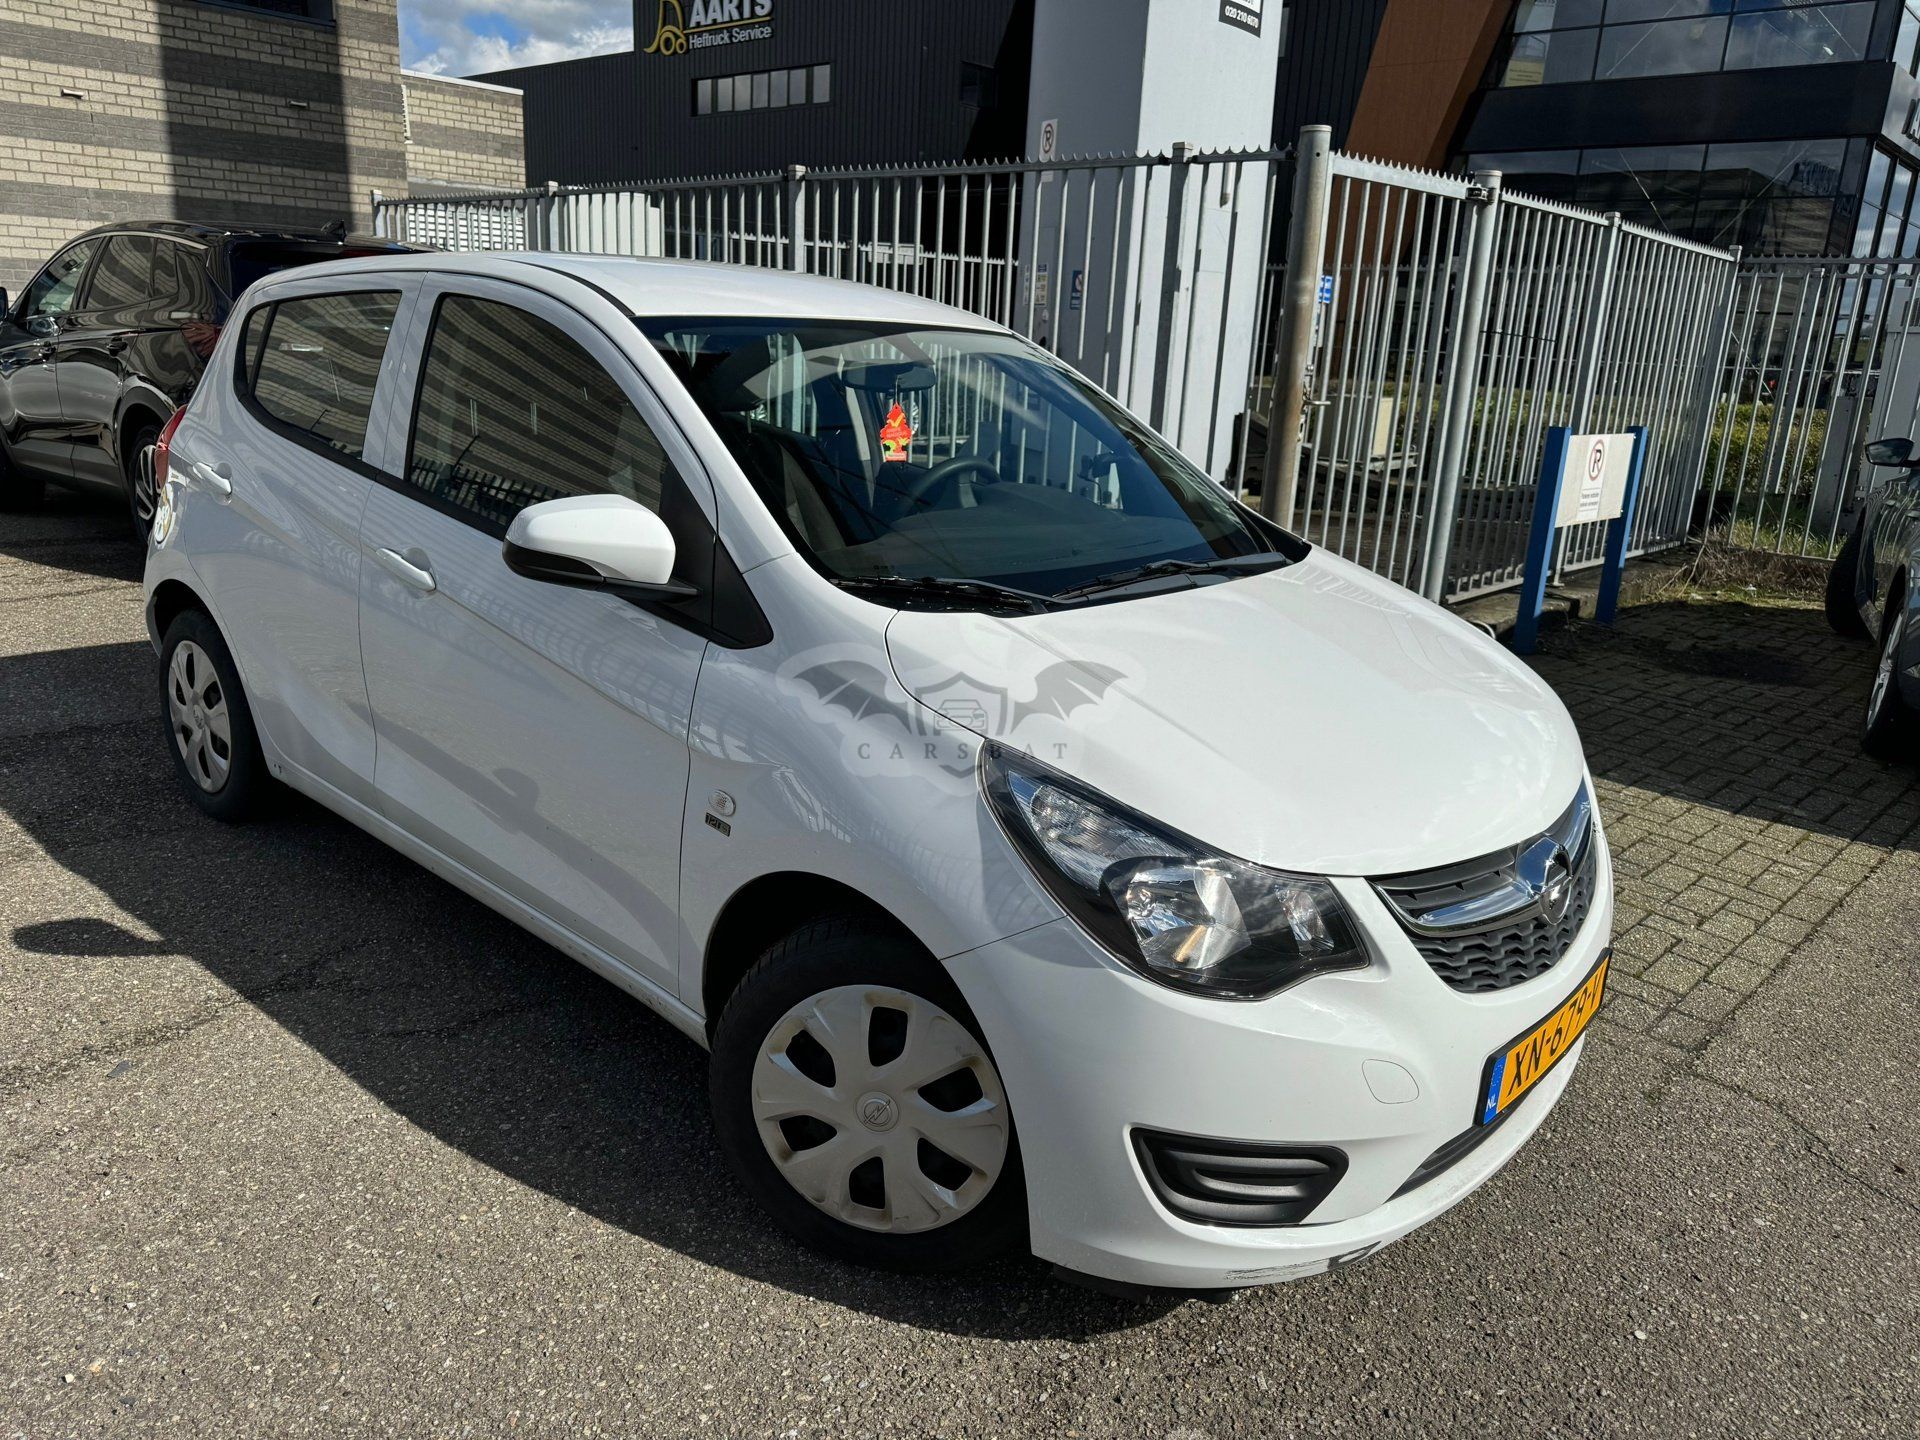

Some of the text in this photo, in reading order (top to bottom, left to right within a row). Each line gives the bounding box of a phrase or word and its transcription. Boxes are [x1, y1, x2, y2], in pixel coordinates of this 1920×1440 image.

[690, 0, 772, 27] AARTS
[1225, 5, 1237, 18] 020
[689, 25, 772, 49] Heftruck Service
